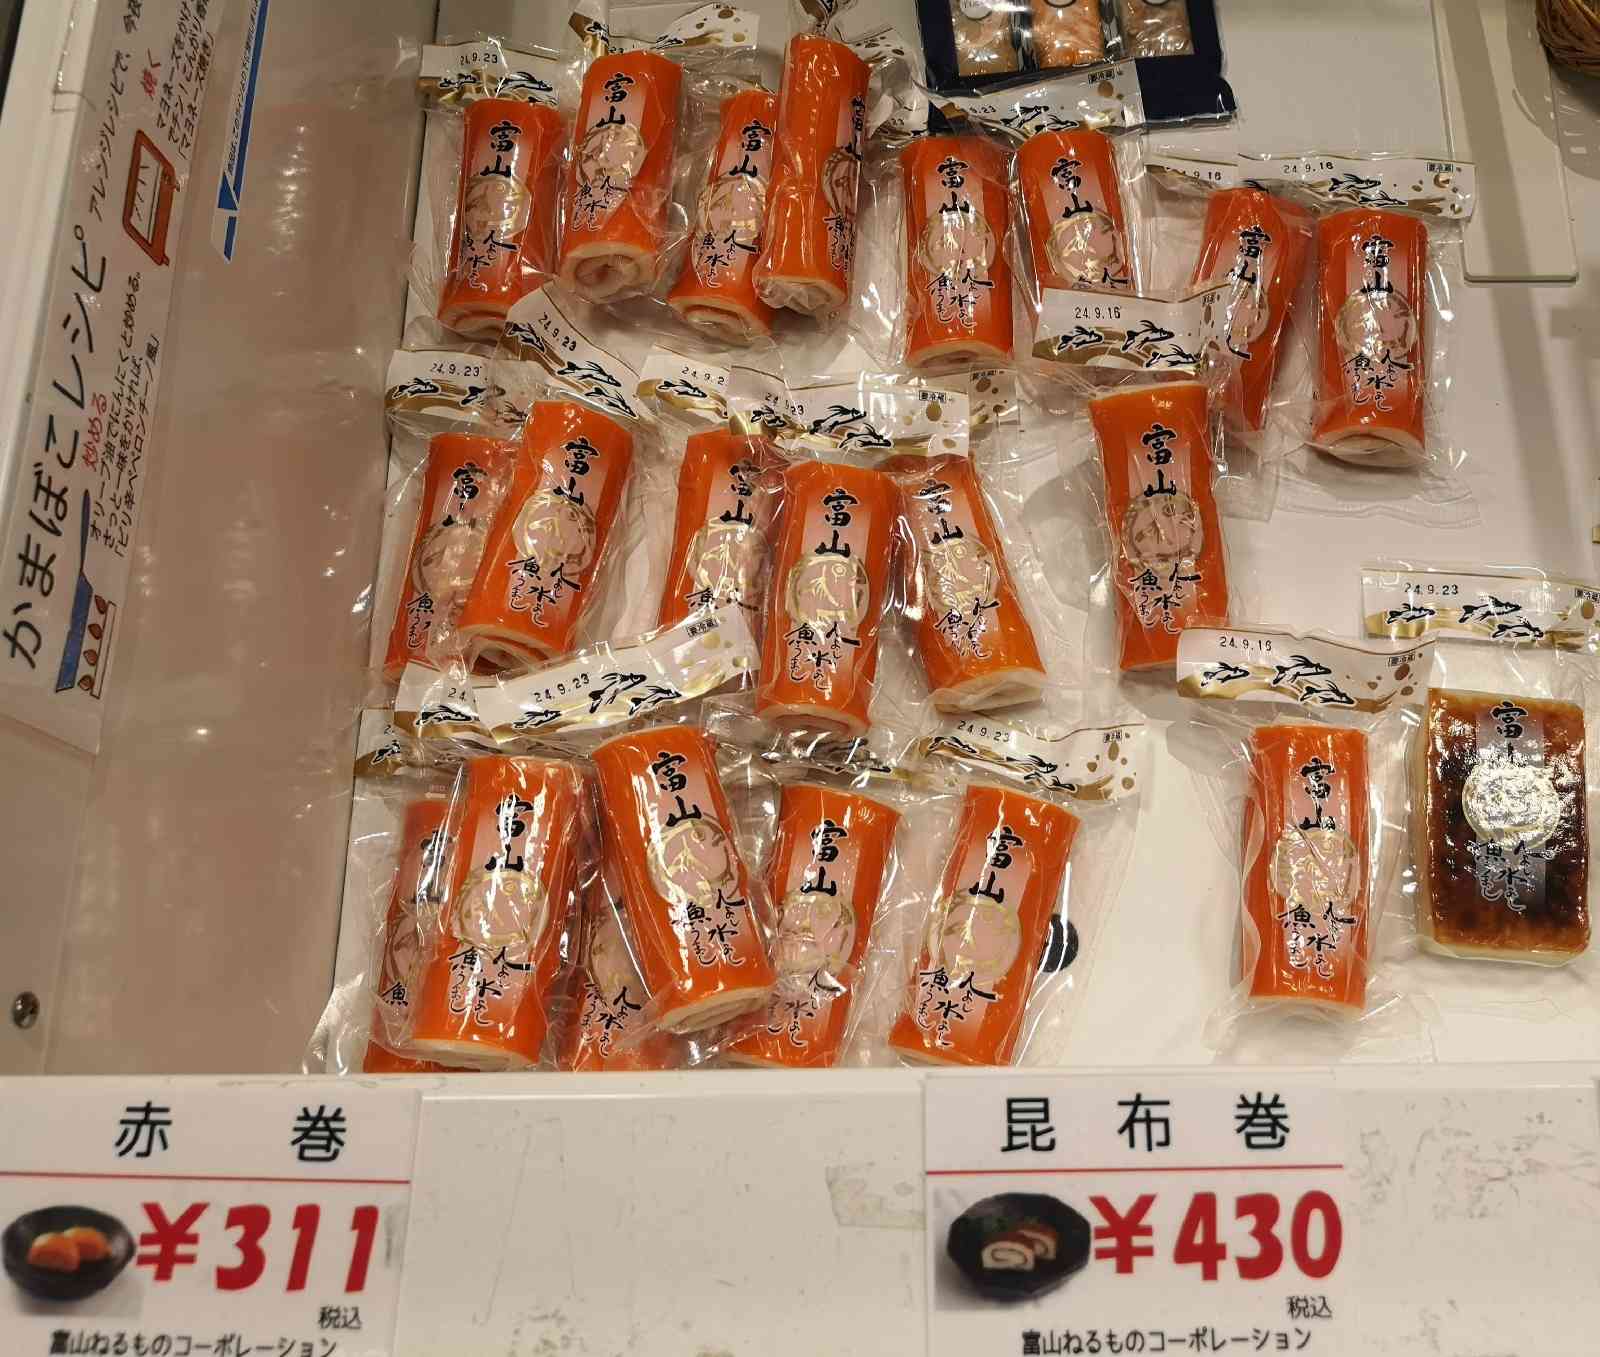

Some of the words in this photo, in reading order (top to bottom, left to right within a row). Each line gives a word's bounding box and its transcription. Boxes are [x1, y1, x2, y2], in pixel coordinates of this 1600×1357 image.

[595, 72, 634, 128] 富山
[480, 120, 522, 177] 富山
[730, 119, 772, 178] 富山
[937, 156, 969, 214] 富山
[1051, 158, 1093, 218] 富山
[1360, 235, 1395, 293] 富山
[681, 366, 726, 386] 24.9.2
[3, 223, 106, 669] かまぼこレシピ
[553, 437, 600, 506] 富山
[1141, 423, 1177, 498] 富山
[814, 487, 858, 558] 富山
[533, 672, 591, 703] 24.9.23
[651, 751, 703, 827] 富山
[1299, 757, 1336, 832] 富山
[801, 819, 847, 897] 富山
[968, 826, 1023, 904] 富山
[136, 1202, 380, 1293] ¥311
[1088, 1190, 1343, 1281] ¥430
[319, 1305, 362, 1330] 税込
[1287, 1295, 1333, 1320] 税込
[48, 1329, 338, 1357] 富山ねるものコーポレーション
[1021, 1327, 1313, 1356] 富山ねるものコーポレーション
